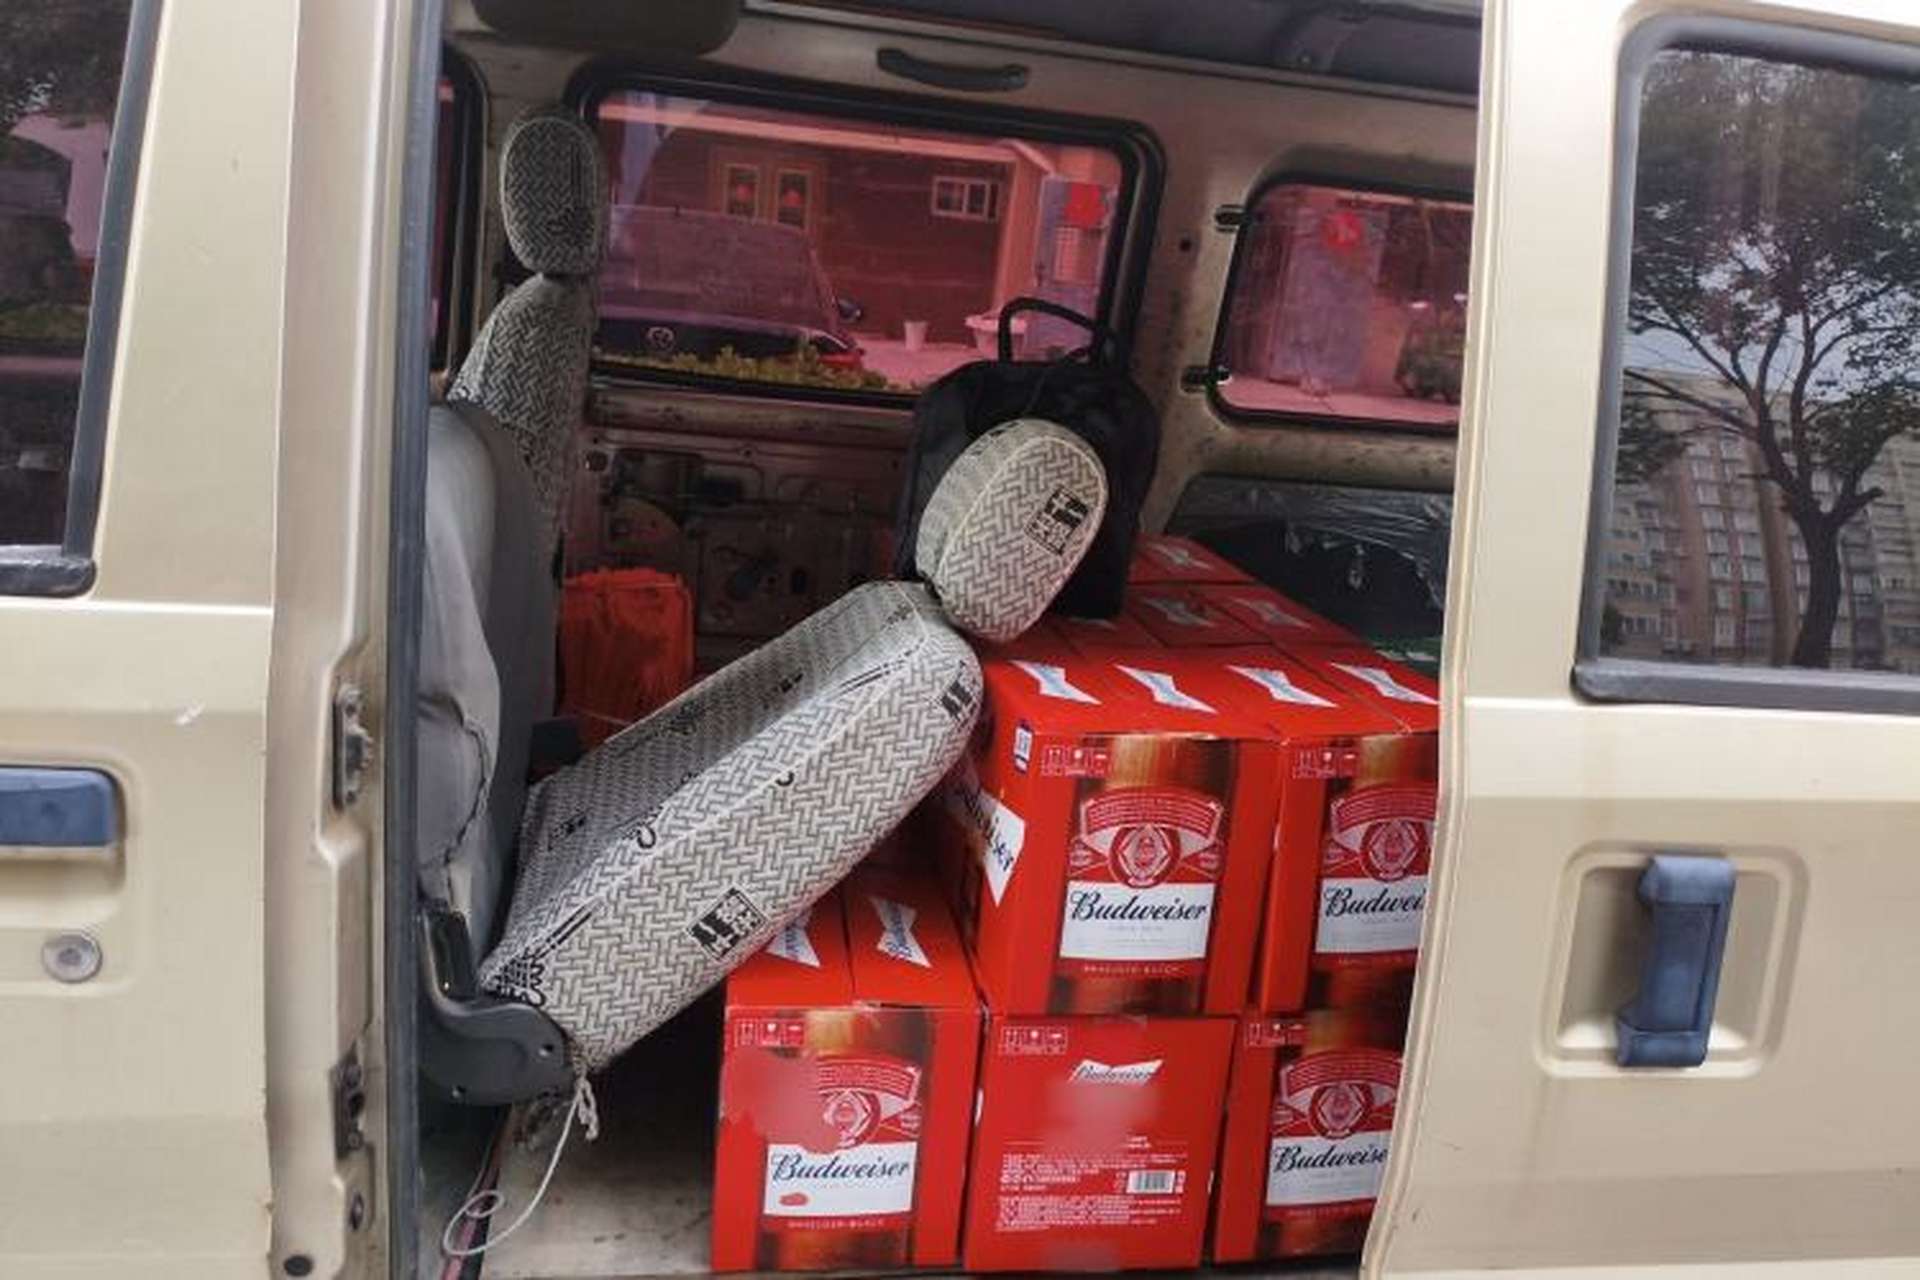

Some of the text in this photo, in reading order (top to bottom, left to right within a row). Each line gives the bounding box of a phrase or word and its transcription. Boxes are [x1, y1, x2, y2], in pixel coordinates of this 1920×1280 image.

[1070, 889, 1207, 921] Budweiser
[1324, 886, 1426, 917] Budwei
[770, 1151, 909, 1181] Budweiser
[1272, 1144, 1388, 1173] Budweise
